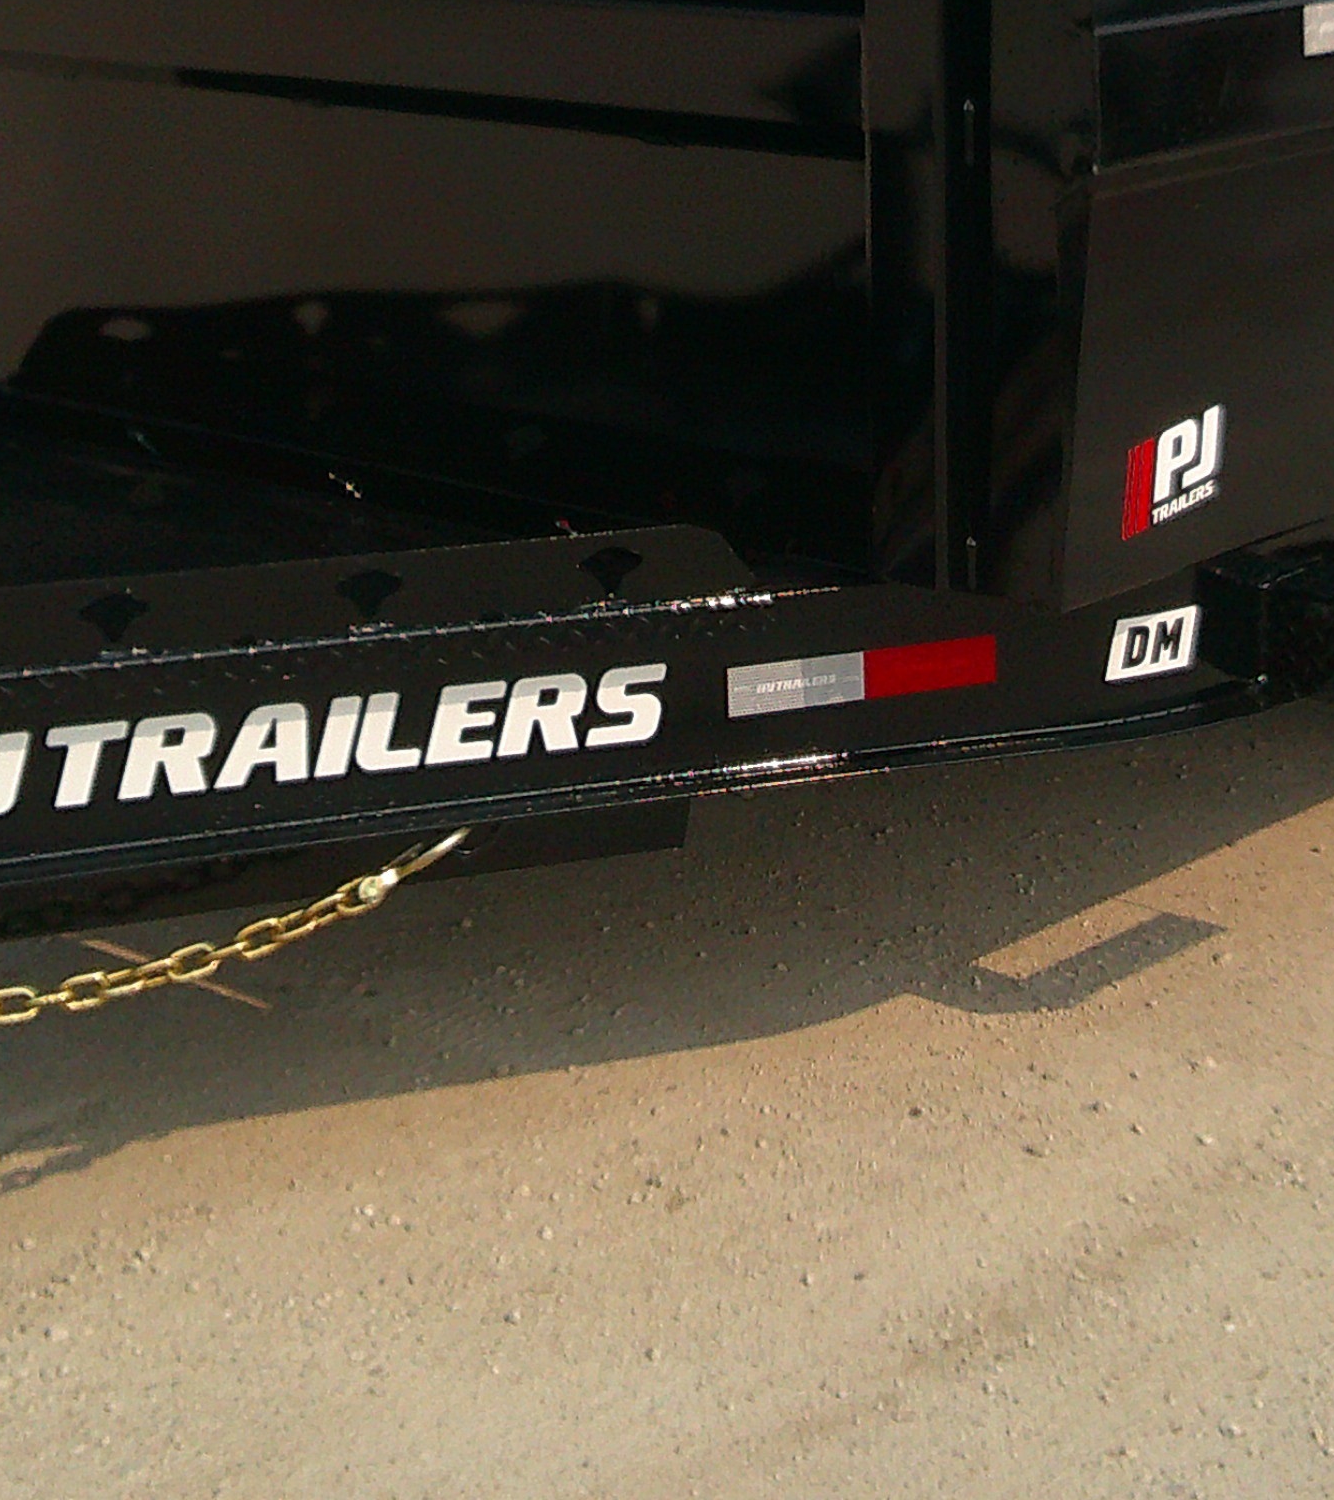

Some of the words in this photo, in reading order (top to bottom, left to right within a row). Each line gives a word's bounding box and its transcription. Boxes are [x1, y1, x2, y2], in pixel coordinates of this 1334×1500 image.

[1153, 403, 1221, 504] PJ
[1151, 480, 1216, 525] TRAILERS
[1121, 616, 1184, 670] DM
[45, 662, 668, 809] TRAILERS
